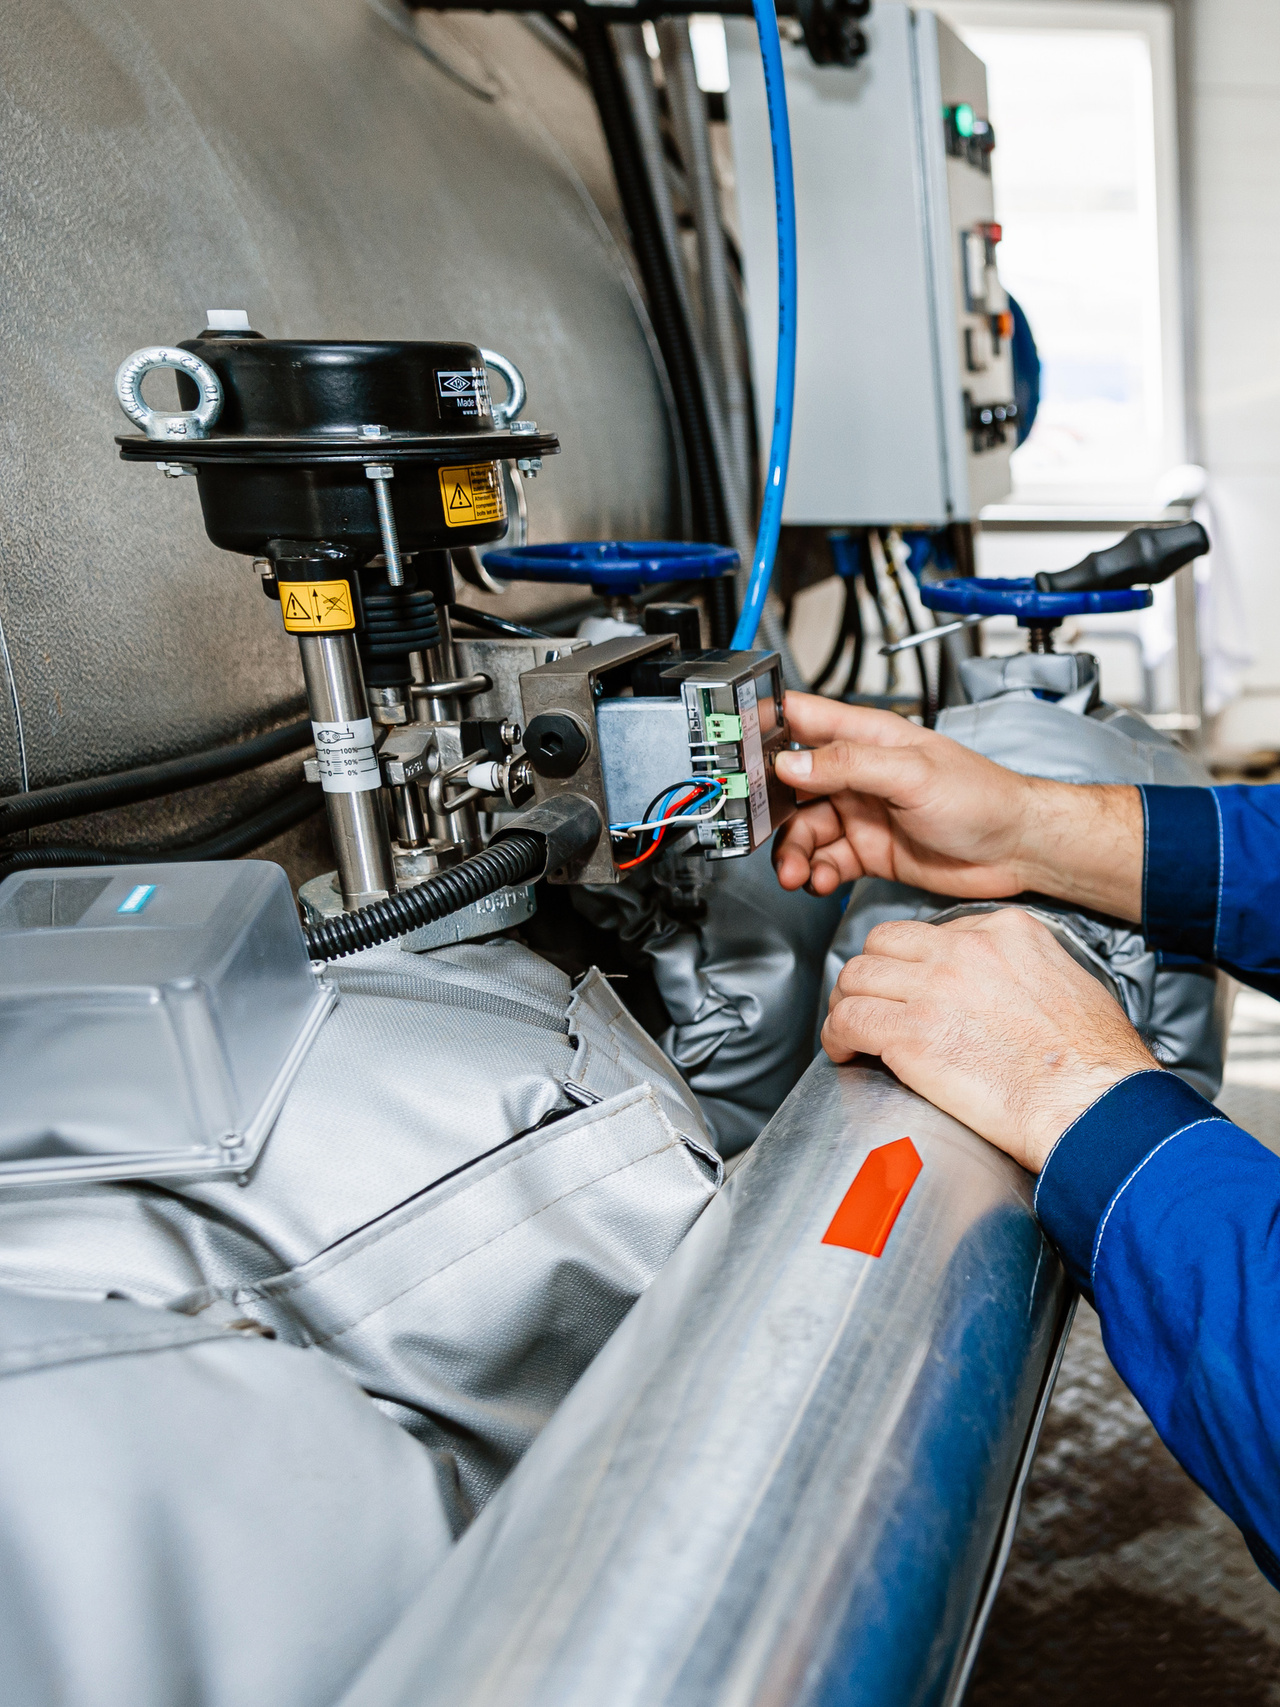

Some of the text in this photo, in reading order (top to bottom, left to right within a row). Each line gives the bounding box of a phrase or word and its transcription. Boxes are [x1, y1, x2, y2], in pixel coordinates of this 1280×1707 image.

[456, 397, 475, 407] Made
[340, 747, 359, 755] 100%
[344, 758, 359, 766] 50%
